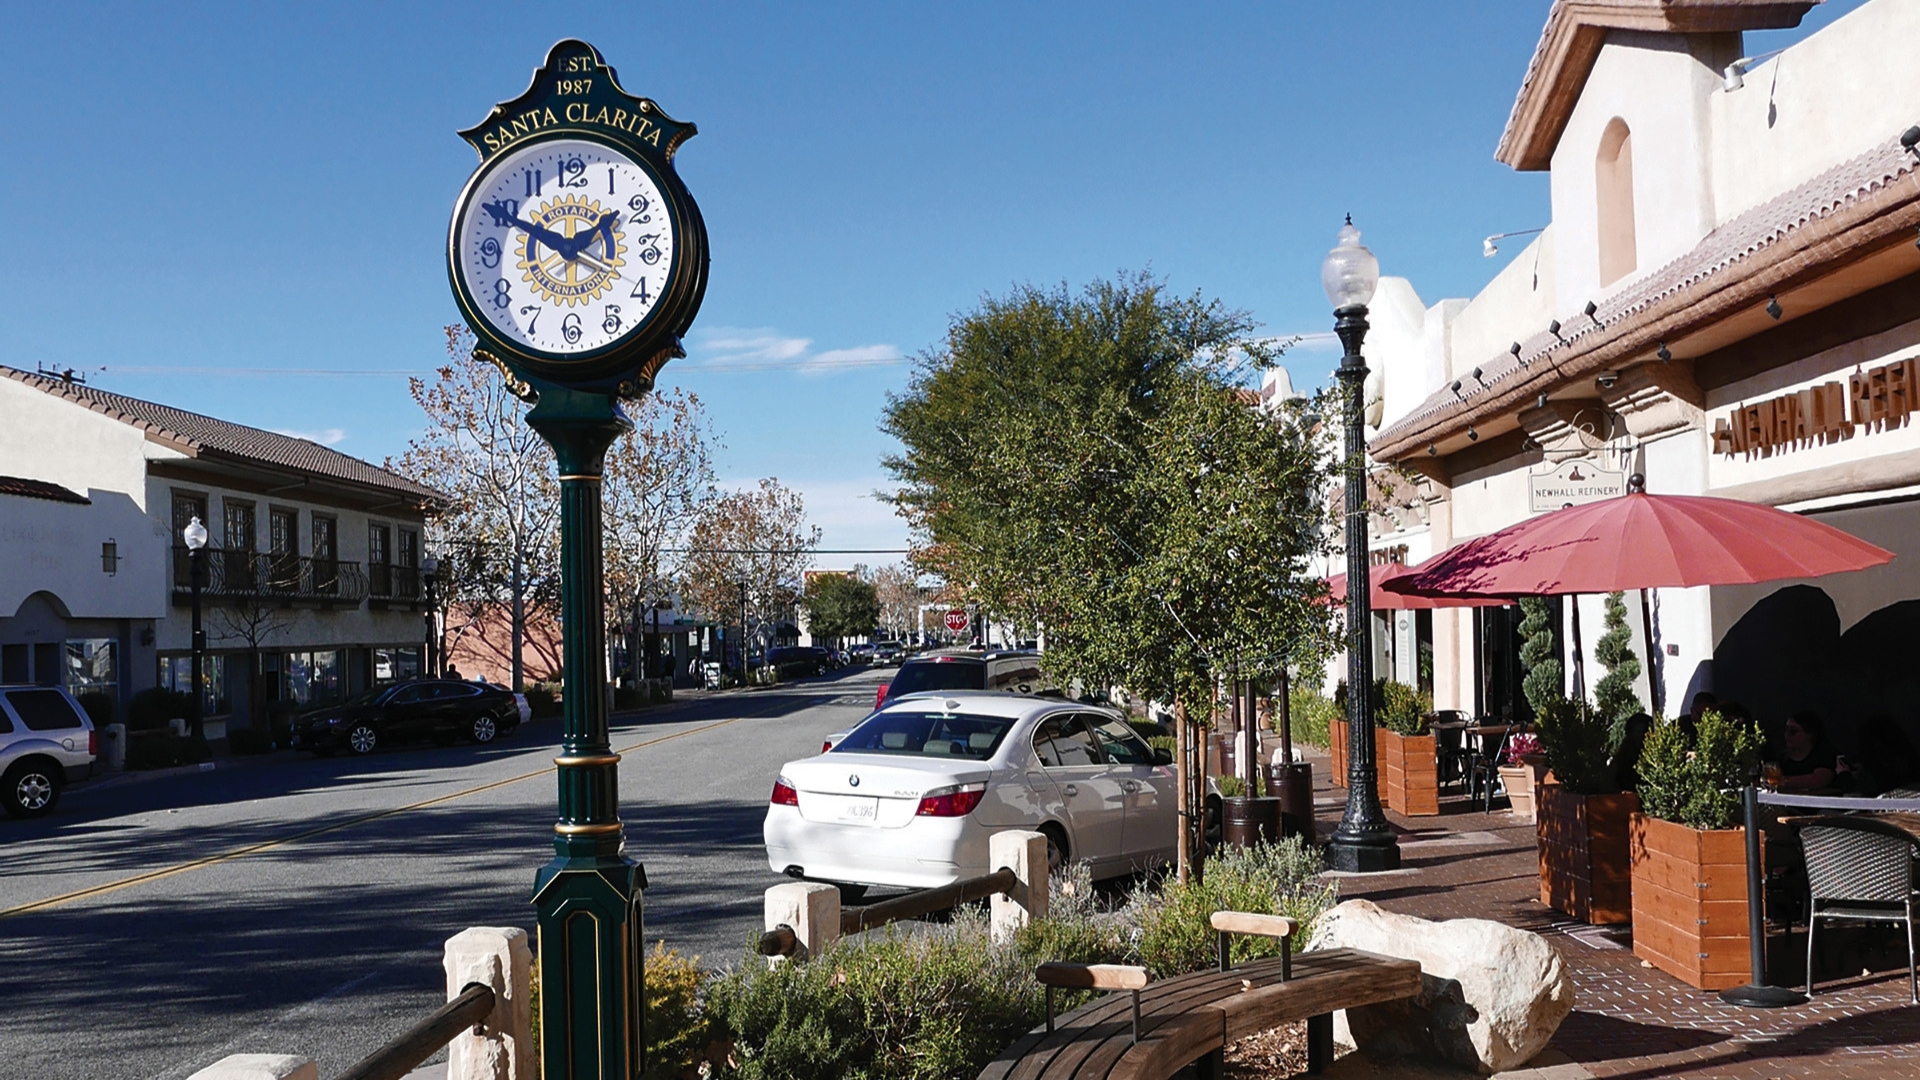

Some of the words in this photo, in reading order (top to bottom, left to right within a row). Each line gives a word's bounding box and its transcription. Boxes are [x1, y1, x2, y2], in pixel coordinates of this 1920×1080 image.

[558, 57, 592, 72] EST.
[557, 79, 592, 95] 1987
[484, 106, 559, 151] SANTA
[566, 103, 662, 147] CLARITA
[525, 169, 542, 197] 11
[557, 157, 588, 188] 12
[608, 167, 615, 196] 1
[548, 205, 594, 221] ROTARY
[627, 194, 651, 224] 2
[480, 237, 503, 269] 9
[638, 233, 663, 266] 3
[493, 278, 512, 309] 8
[533, 269, 608, 295] INTERNATIONA
[630, 276, 651, 305] 4
[520, 305, 541, 336] 7
[561, 313, 583, 344] 6
[602, 304, 622, 335] 5
[1730, 381, 1852, 454] NEWHALL
[1849, 354, 1920, 425] REFI
[1535, 489, 1576, 498] NEWHALL
[1578, 486, 1620, 497] REFINERY
